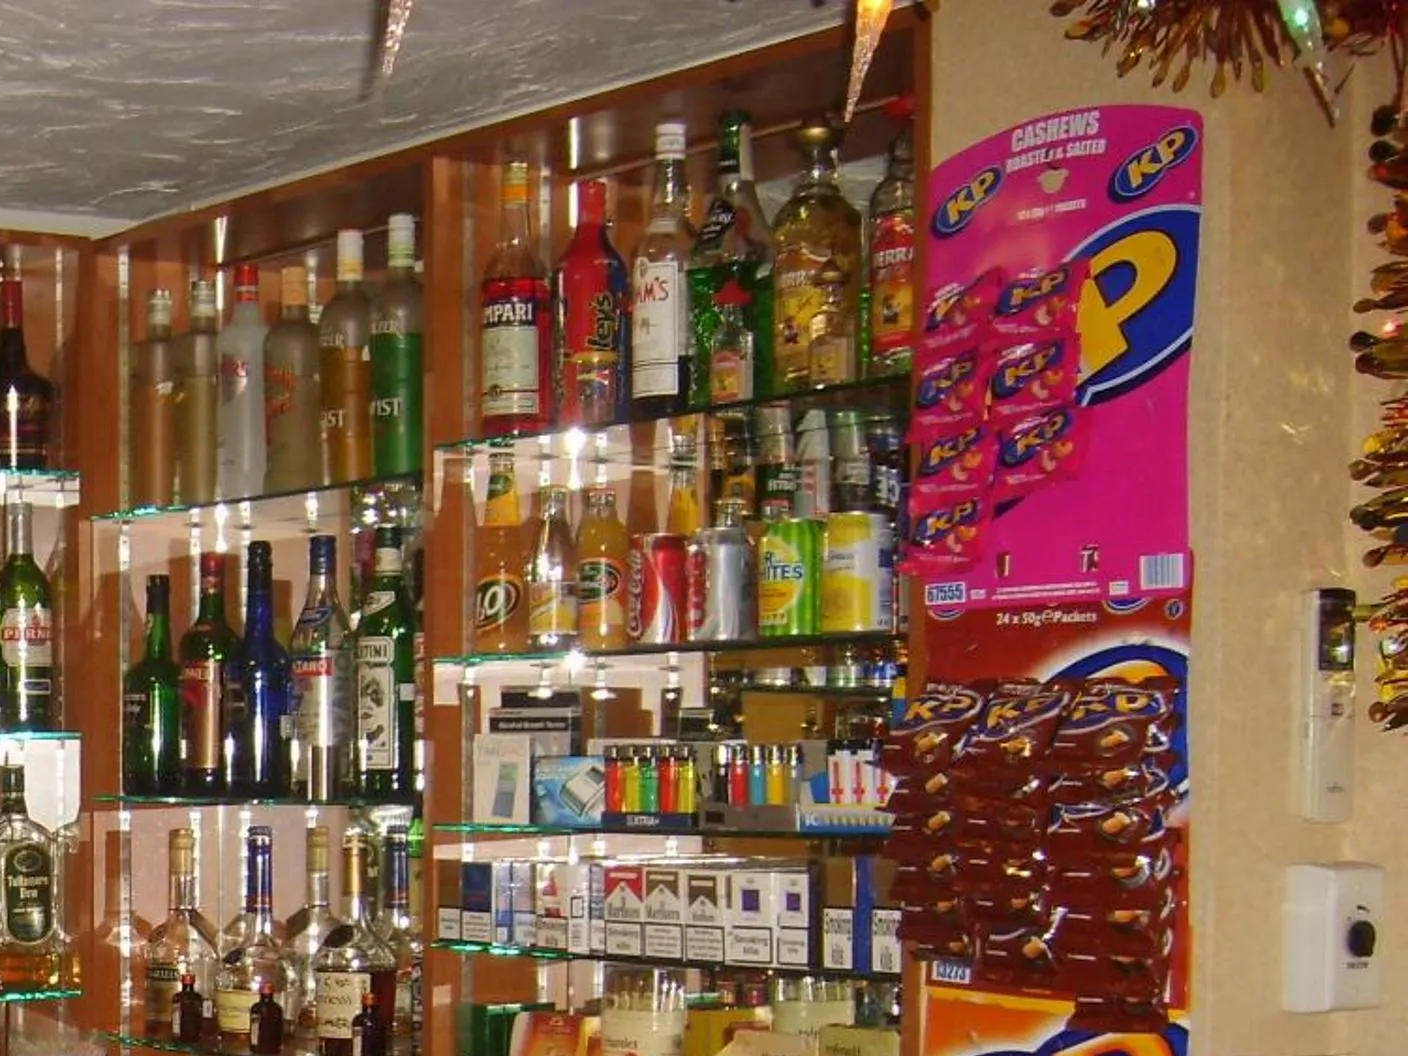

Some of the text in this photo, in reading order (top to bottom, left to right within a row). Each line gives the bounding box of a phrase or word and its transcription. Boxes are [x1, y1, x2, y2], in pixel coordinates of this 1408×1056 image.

[1011, 111, 1100, 152] CASHEWS
[1127, 131, 1186, 189] KP
[946, 171, 996, 225] KP
[996, 611, 1009, 625] 24
[1053, 610, 1098, 624] Packets
